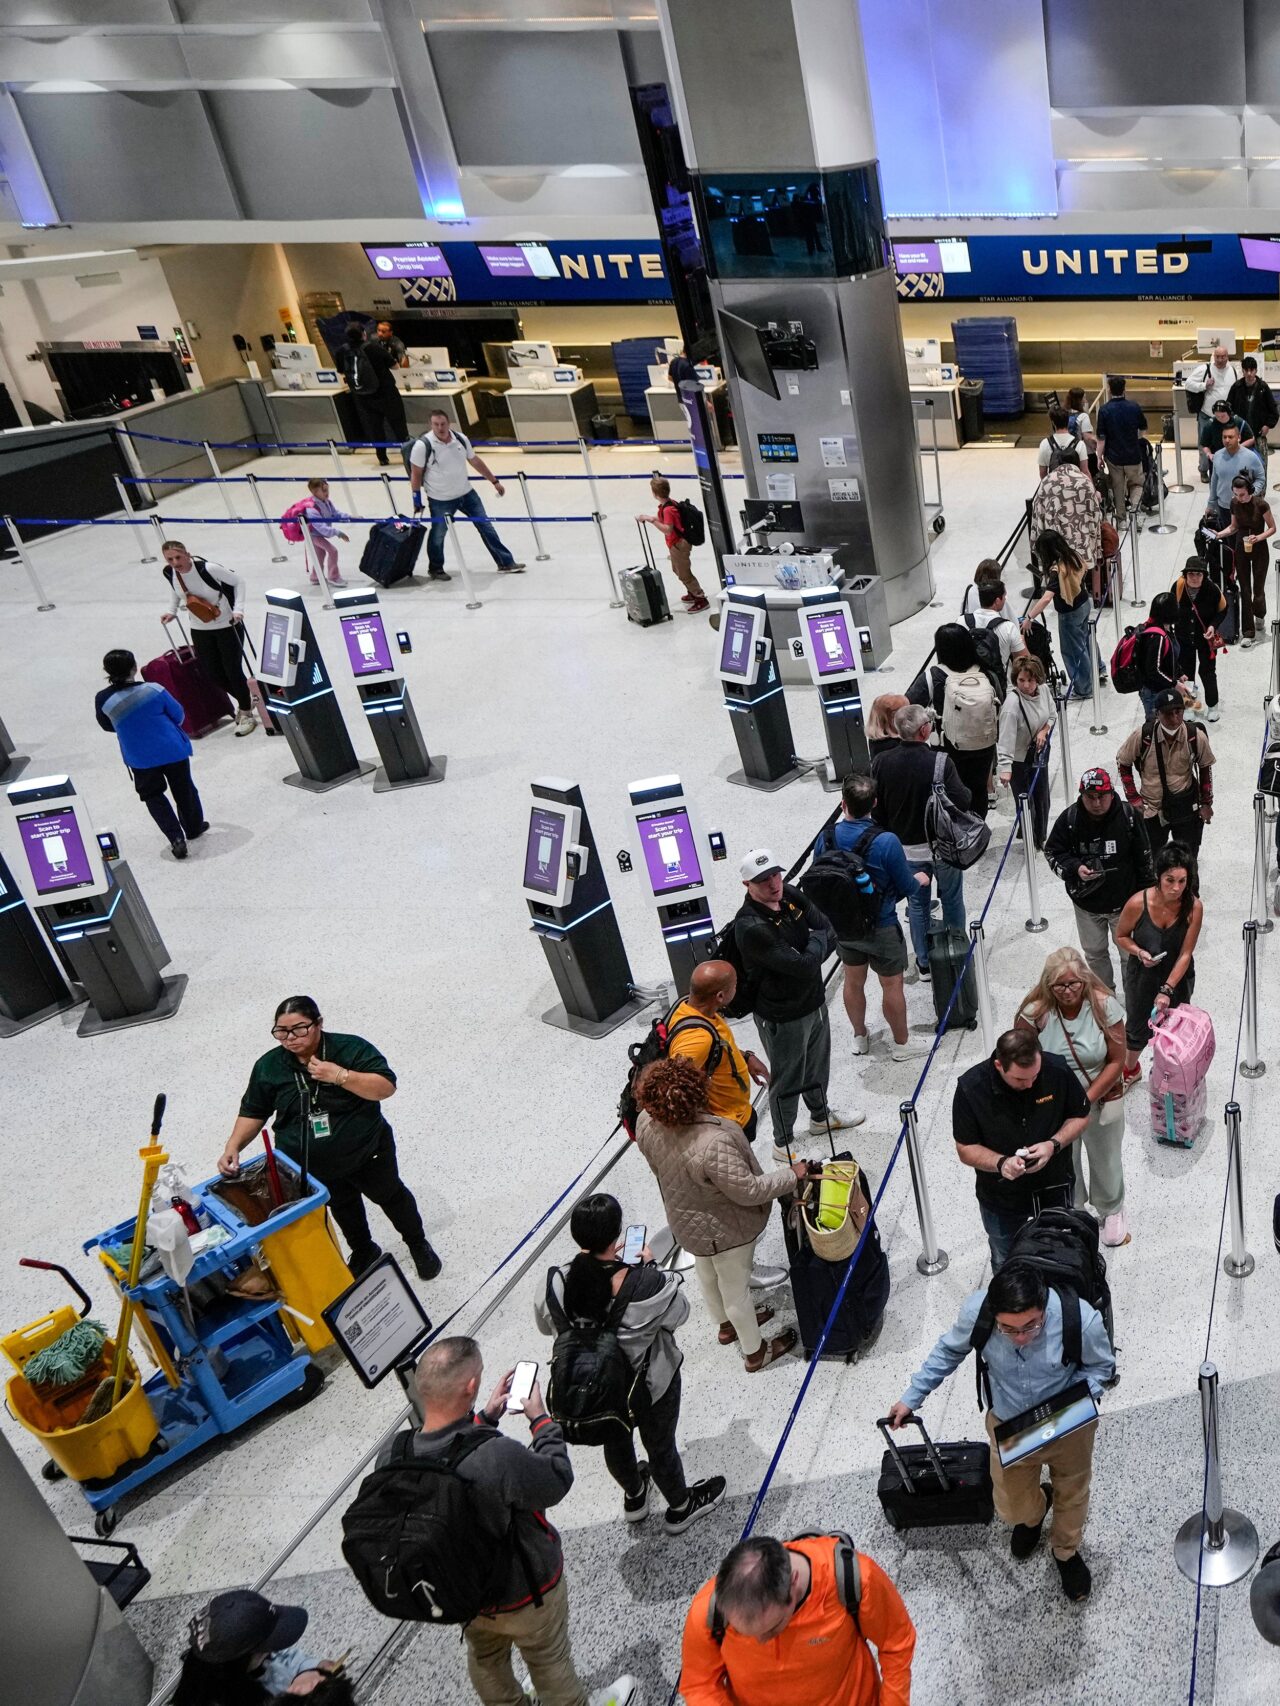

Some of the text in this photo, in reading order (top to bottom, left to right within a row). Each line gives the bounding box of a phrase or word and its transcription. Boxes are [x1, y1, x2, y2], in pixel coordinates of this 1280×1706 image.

[558, 254, 665, 280] NITE
[1022, 249, 1189, 275] UNITED
[30, 832, 44, 840] start
[45, 830, 59, 838] your
[662, 830, 673, 838] your
